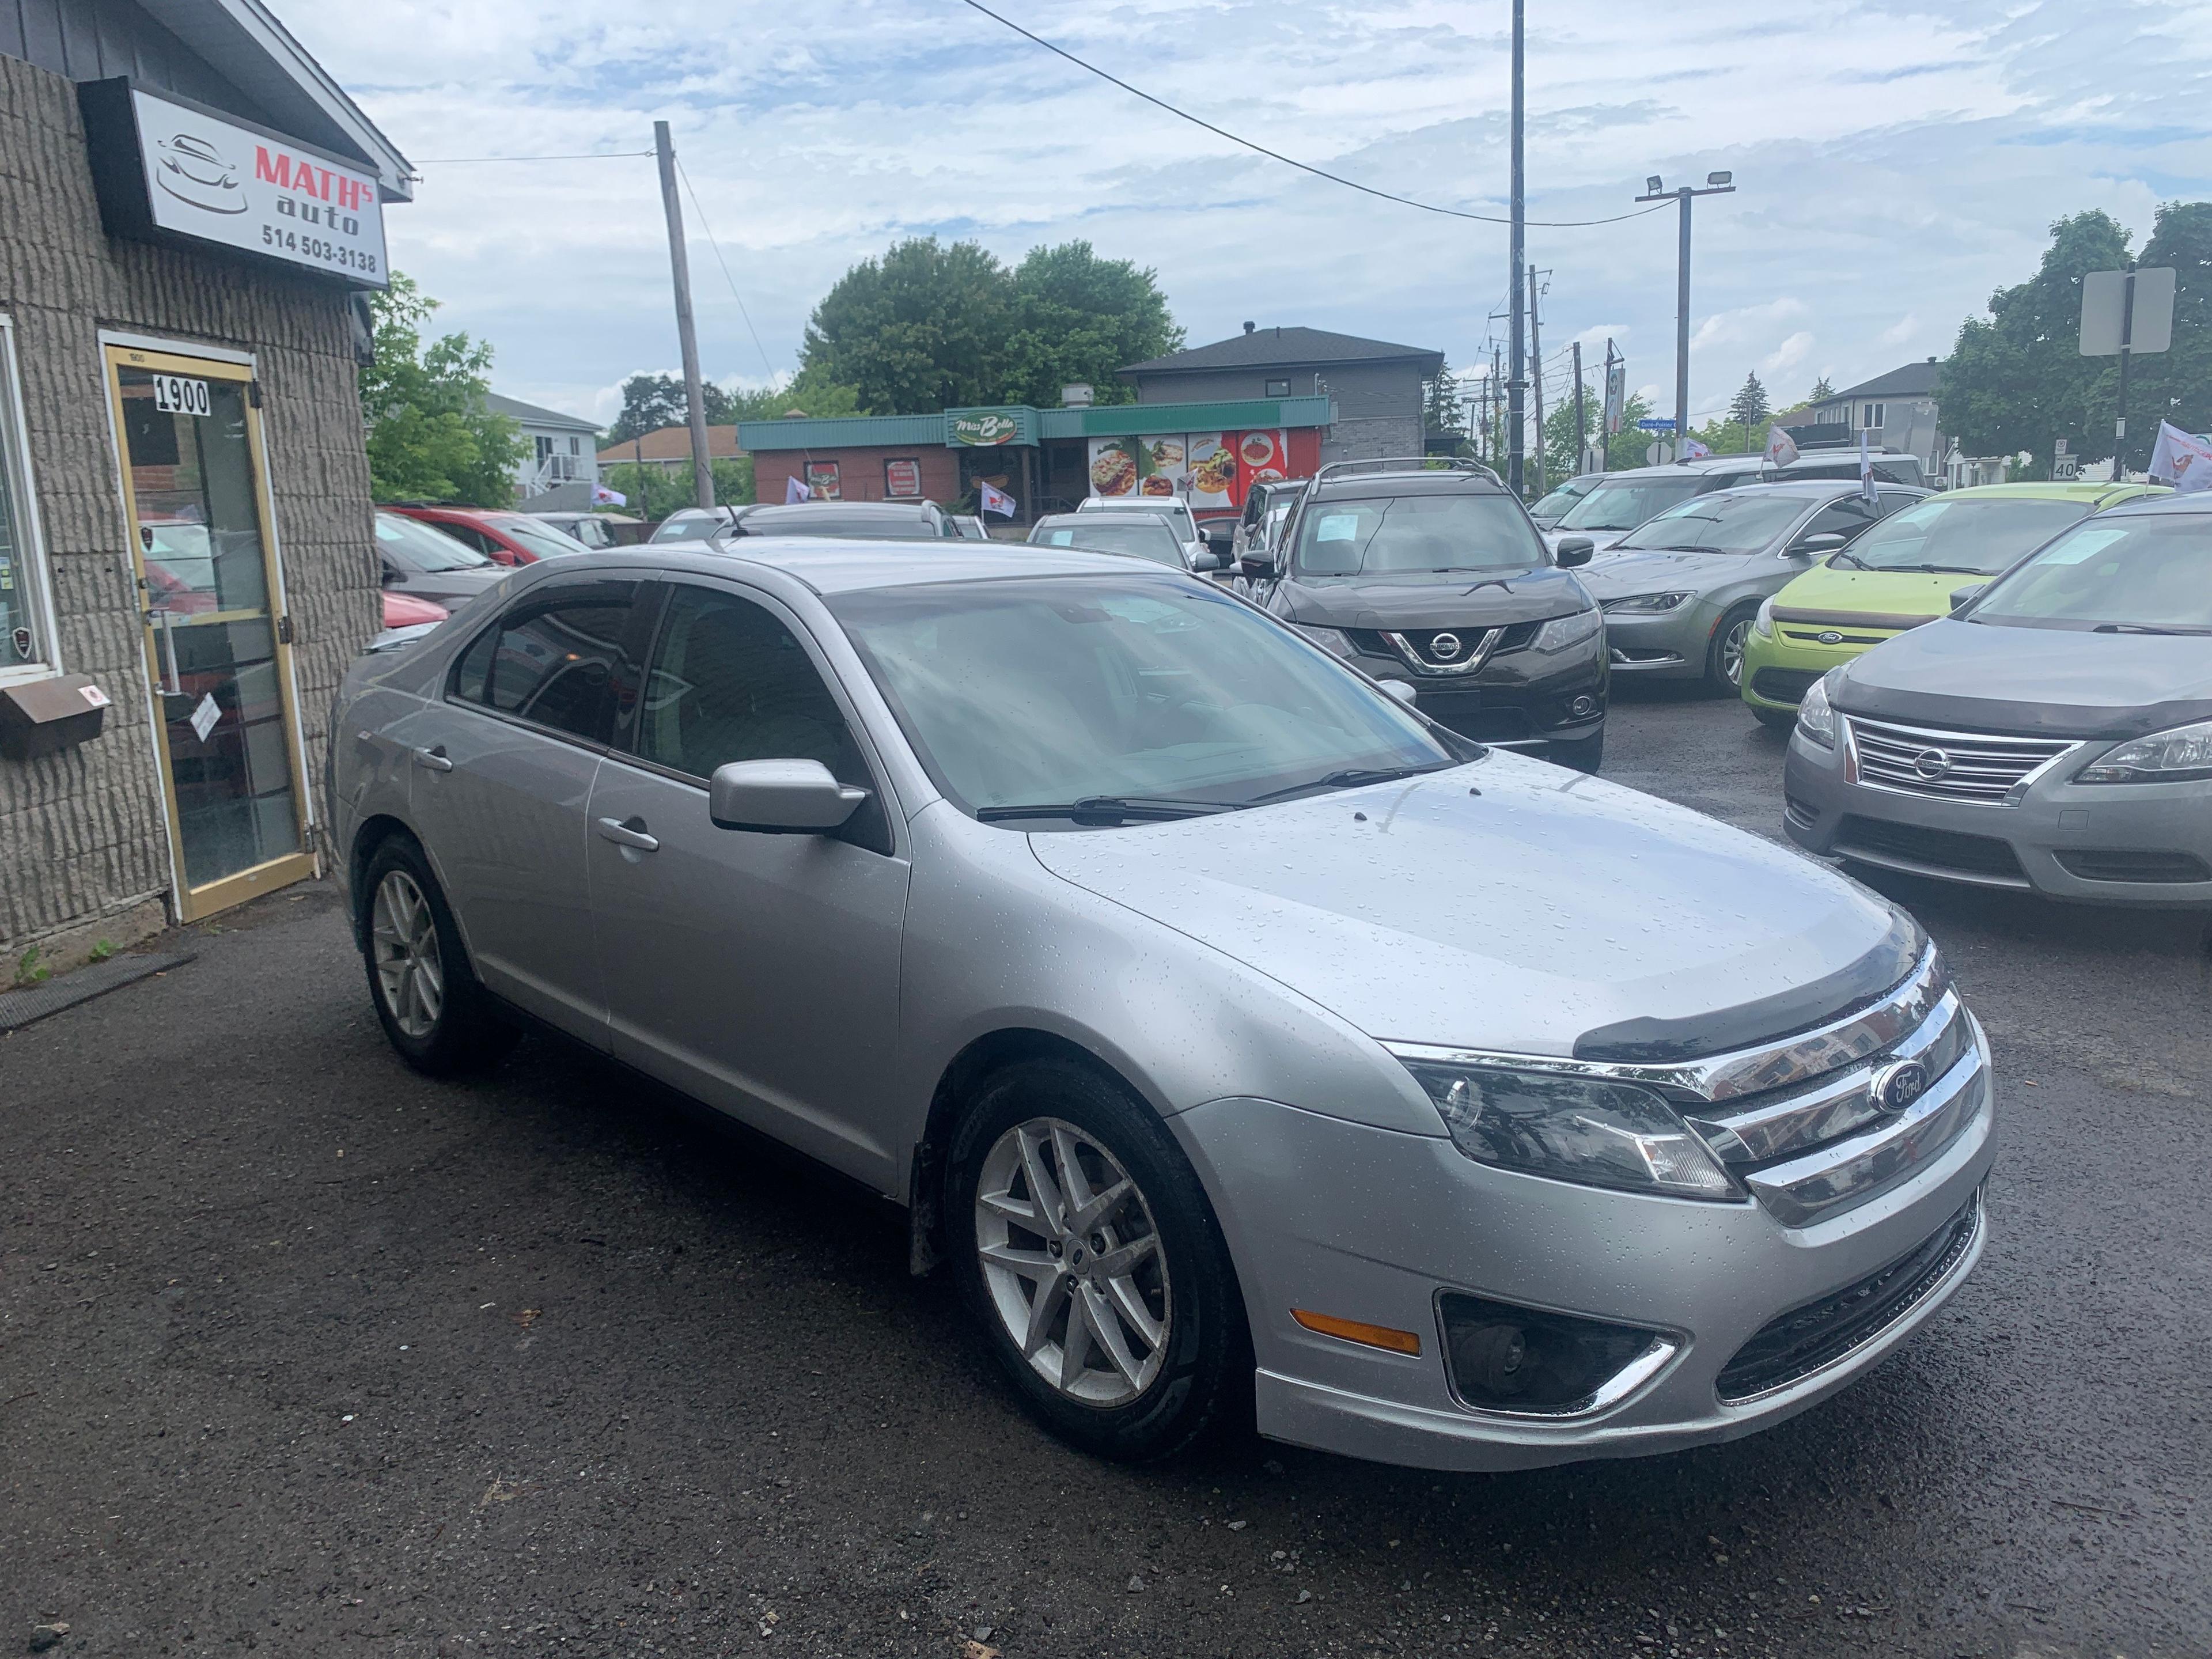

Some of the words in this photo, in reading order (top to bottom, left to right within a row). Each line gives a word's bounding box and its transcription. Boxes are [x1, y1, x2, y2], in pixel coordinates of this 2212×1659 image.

[277, 195, 359, 236] auto
[262, 224, 297, 251] 514
[301, 235, 376, 273] 503-3138
[157, 377, 207, 414] 1900
[980, 416, 1014, 437] Bella
[2055, 464, 2074, 476] 40
[1916, 759, 1945, 768] NISSAN
[1896, 1070, 1921, 1103] Ford
